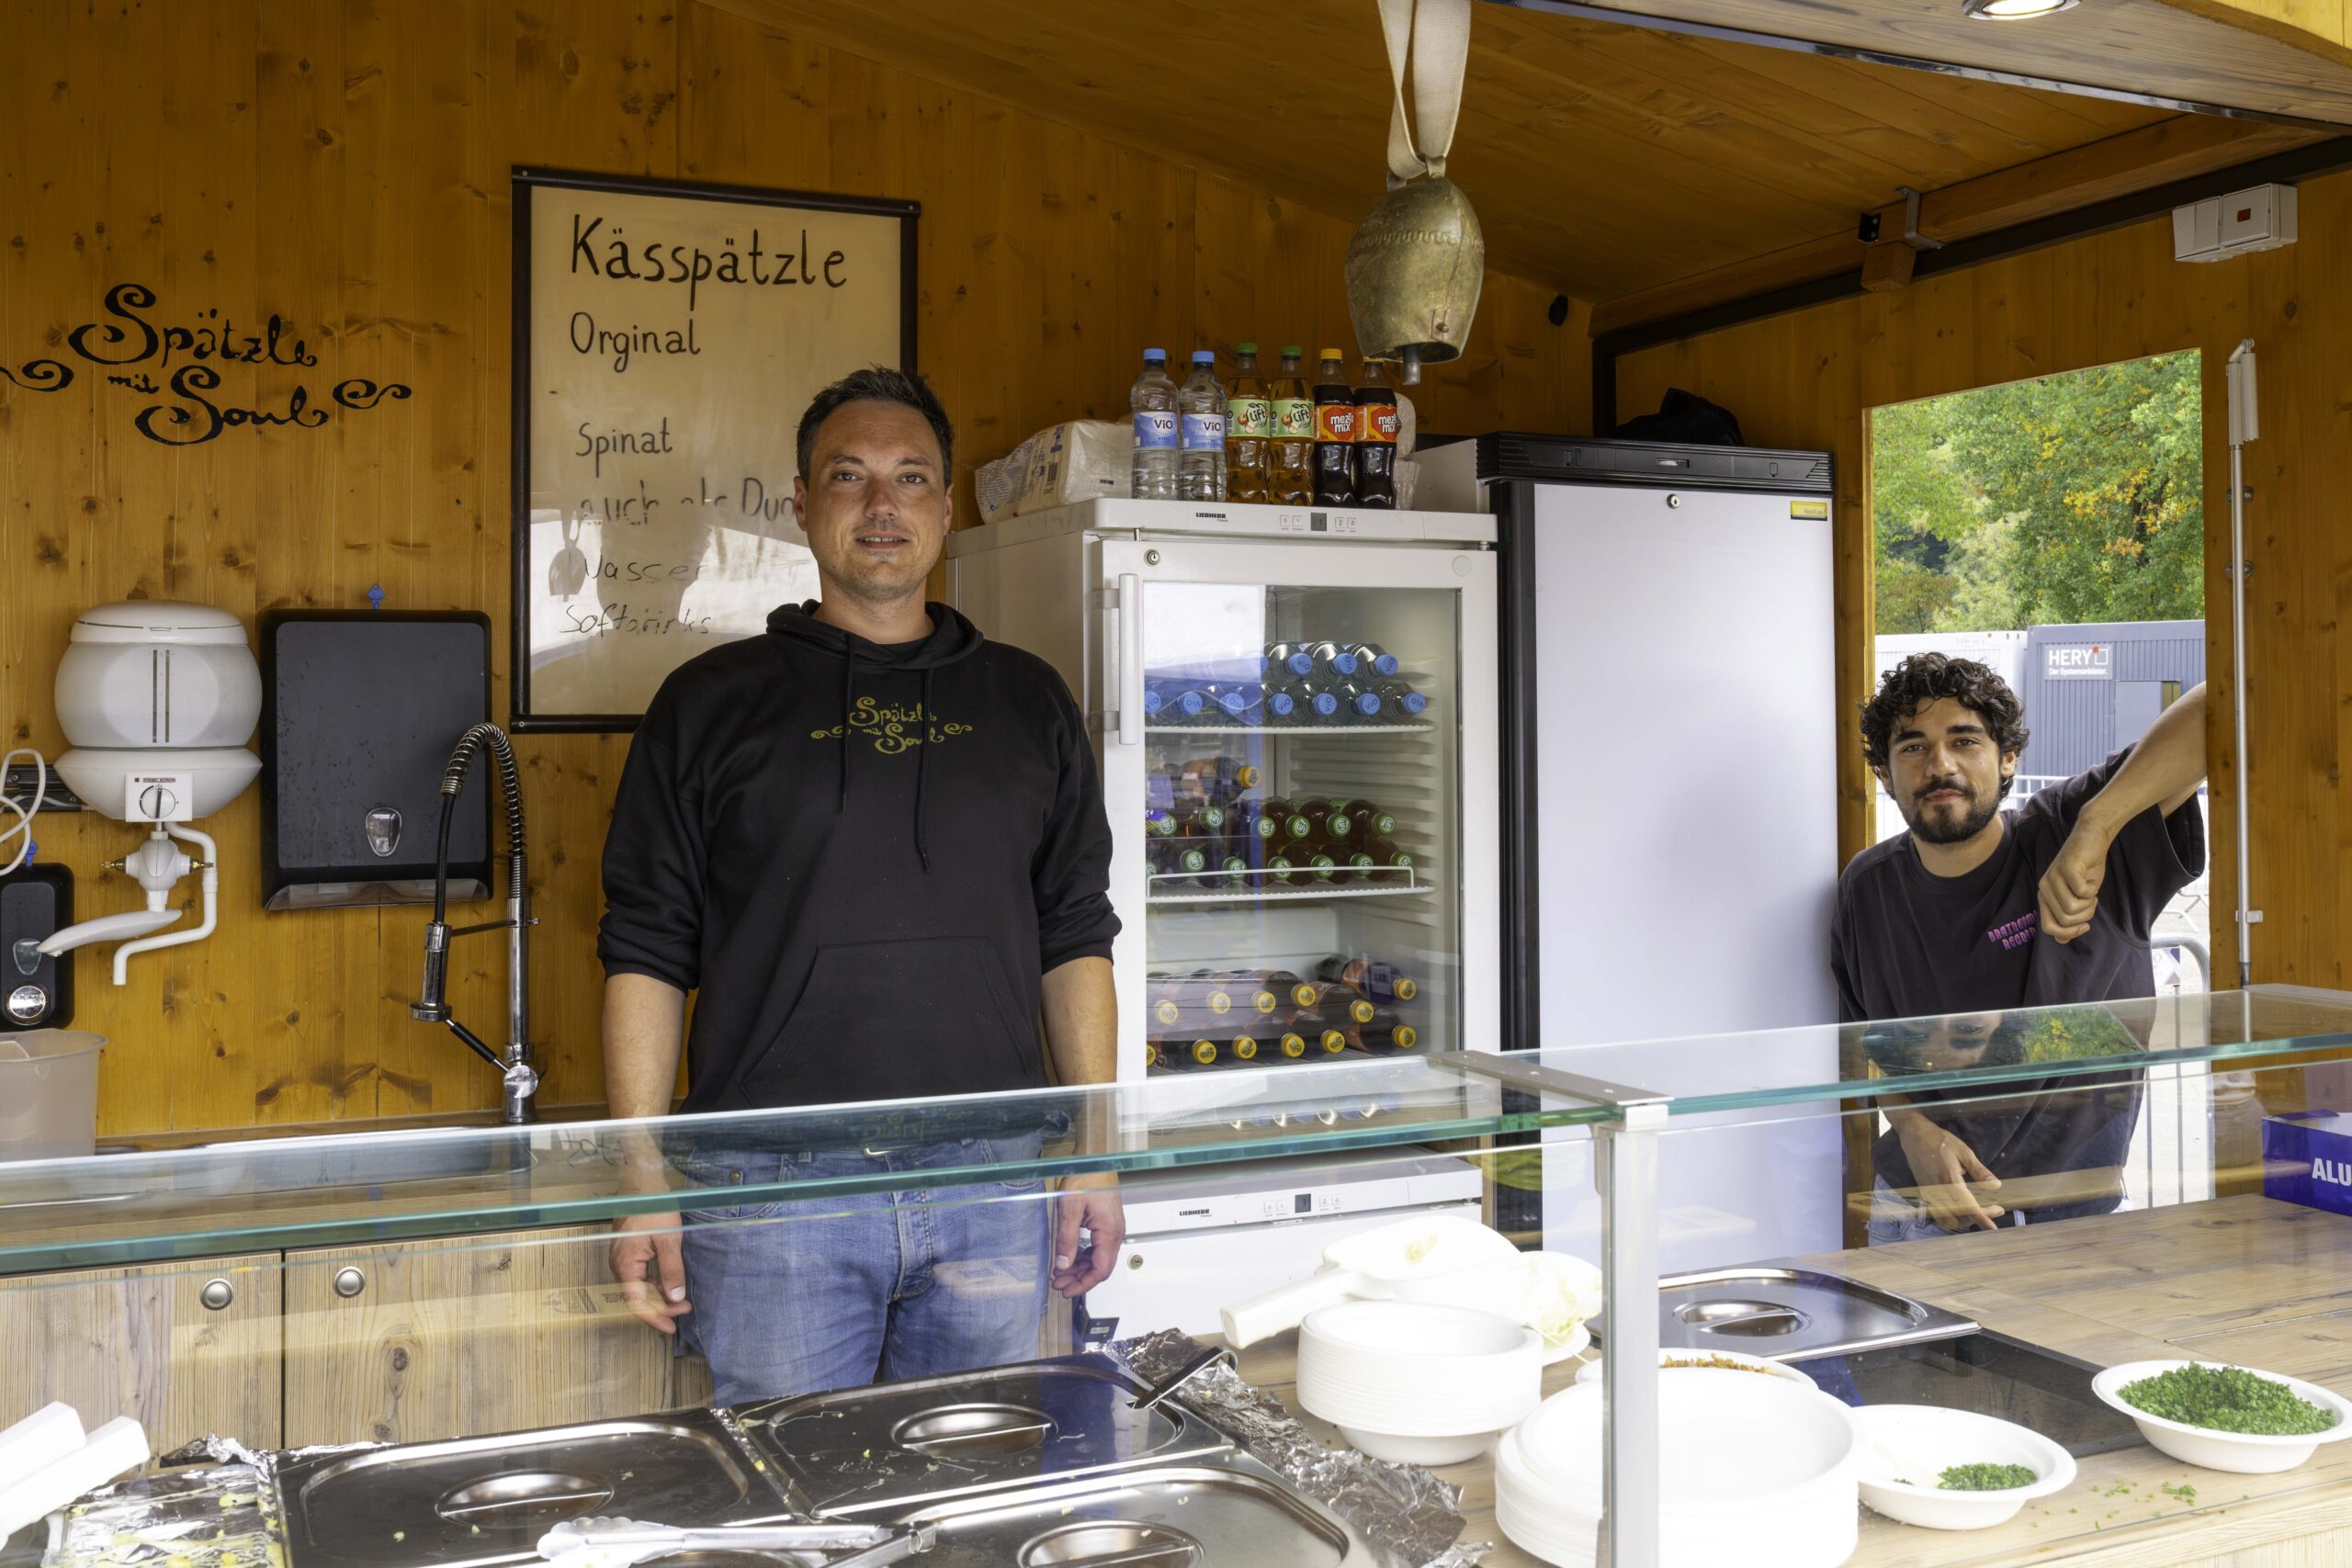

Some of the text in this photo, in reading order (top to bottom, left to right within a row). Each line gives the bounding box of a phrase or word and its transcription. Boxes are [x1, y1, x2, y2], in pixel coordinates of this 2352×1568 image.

[571, 213, 847, 312] Kässpätzle
[67, 282, 318, 367] Spätzle
[570, 310, 702, 373] Orginal
[107, 365, 329, 446] mit Soul
[575, 416, 673, 479] Spinat
[2048, 649, 2093, 666] HERY
[2312, 1157, 2352, 1186] ALU
